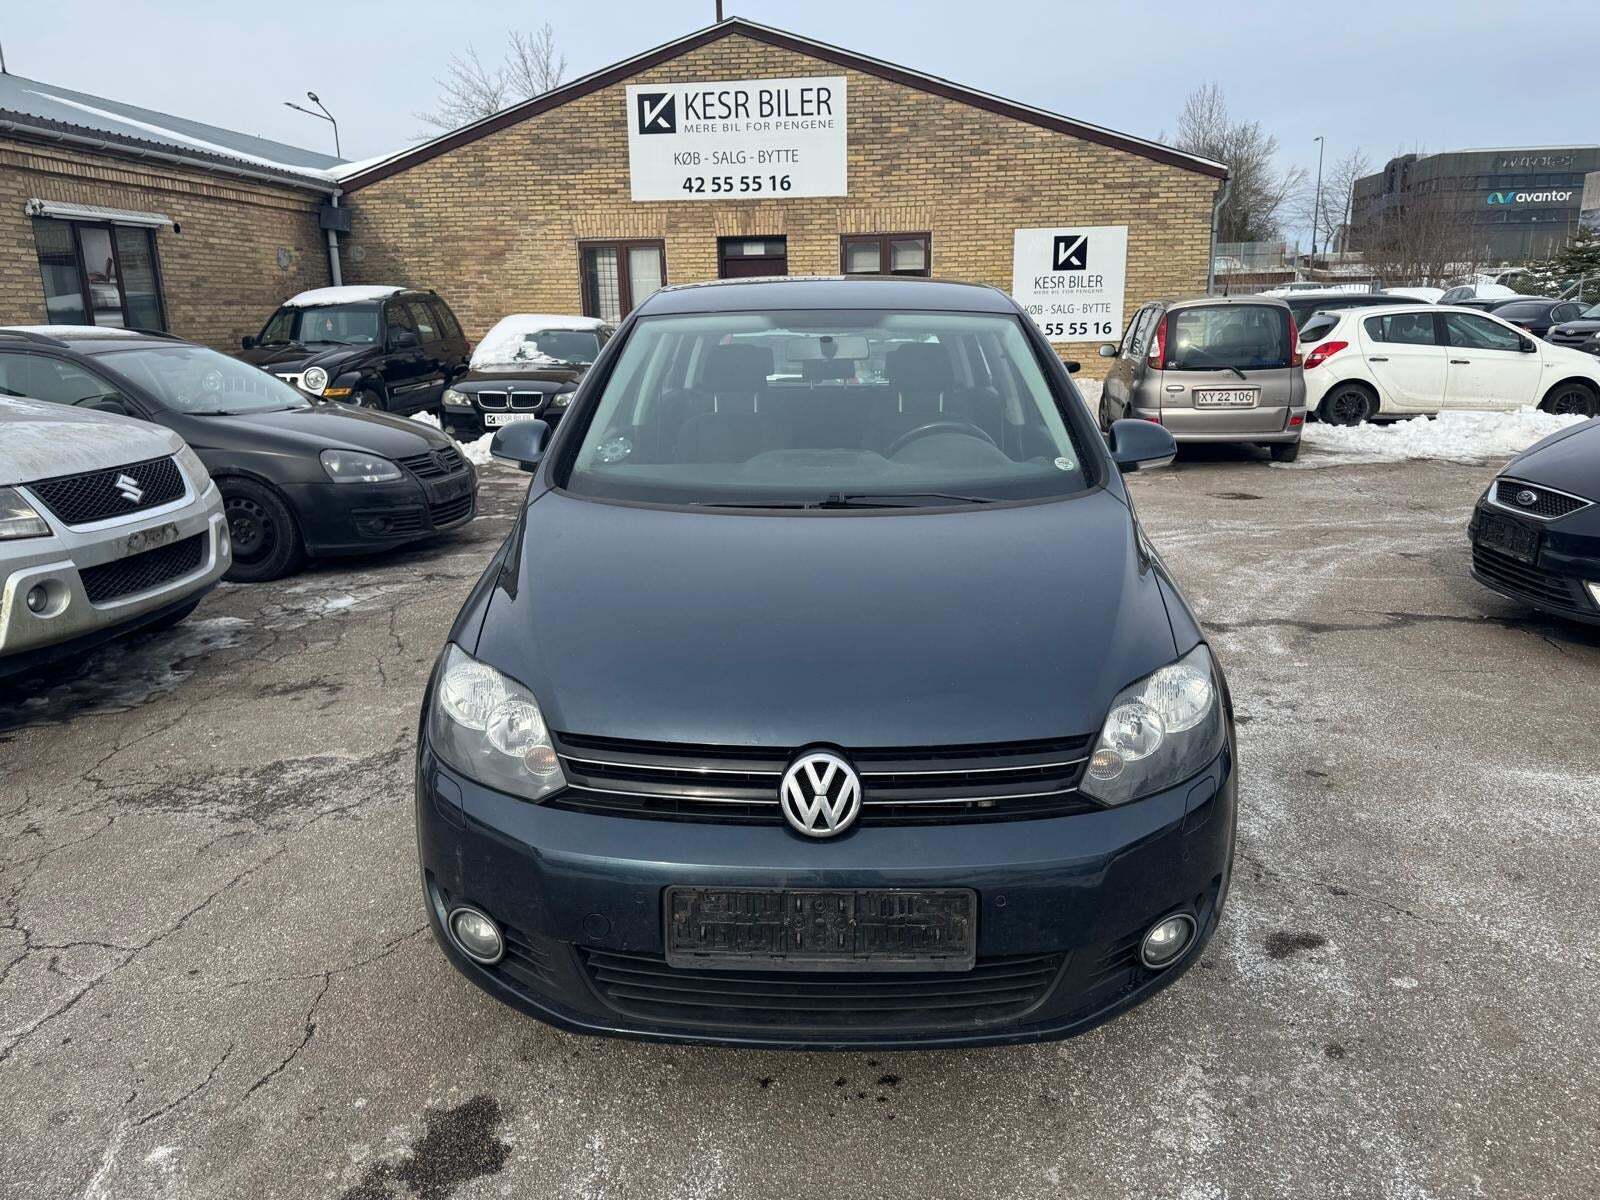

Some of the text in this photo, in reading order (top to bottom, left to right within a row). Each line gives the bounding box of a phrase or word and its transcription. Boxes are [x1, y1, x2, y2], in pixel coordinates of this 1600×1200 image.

[684, 87, 833, 121] KESR BILER
[684, 120, 835, 133] MERE BIL FOR PENGENE
[674, 152, 701, 166] KØB
[712, 150, 746, 165] SALG
[757, 149, 799, 164] BYTTE
[682, 175, 792, 193] 42 55 55 16
[1516, 190, 1573, 203] avantor
[1034, 275, 1103, 289] KESR BILER
[1024, 304, 1043, 315] KØB
[1050, 304, 1075, 314] SALG
[1082, 303, 1111, 313] BYTTE
[1045, 322, 1064, 336] 55
[1068, 322, 1088, 335] 55
[1093, 321, 1112, 335] 16
[1200, 391, 1252, 402] XY 22 106
